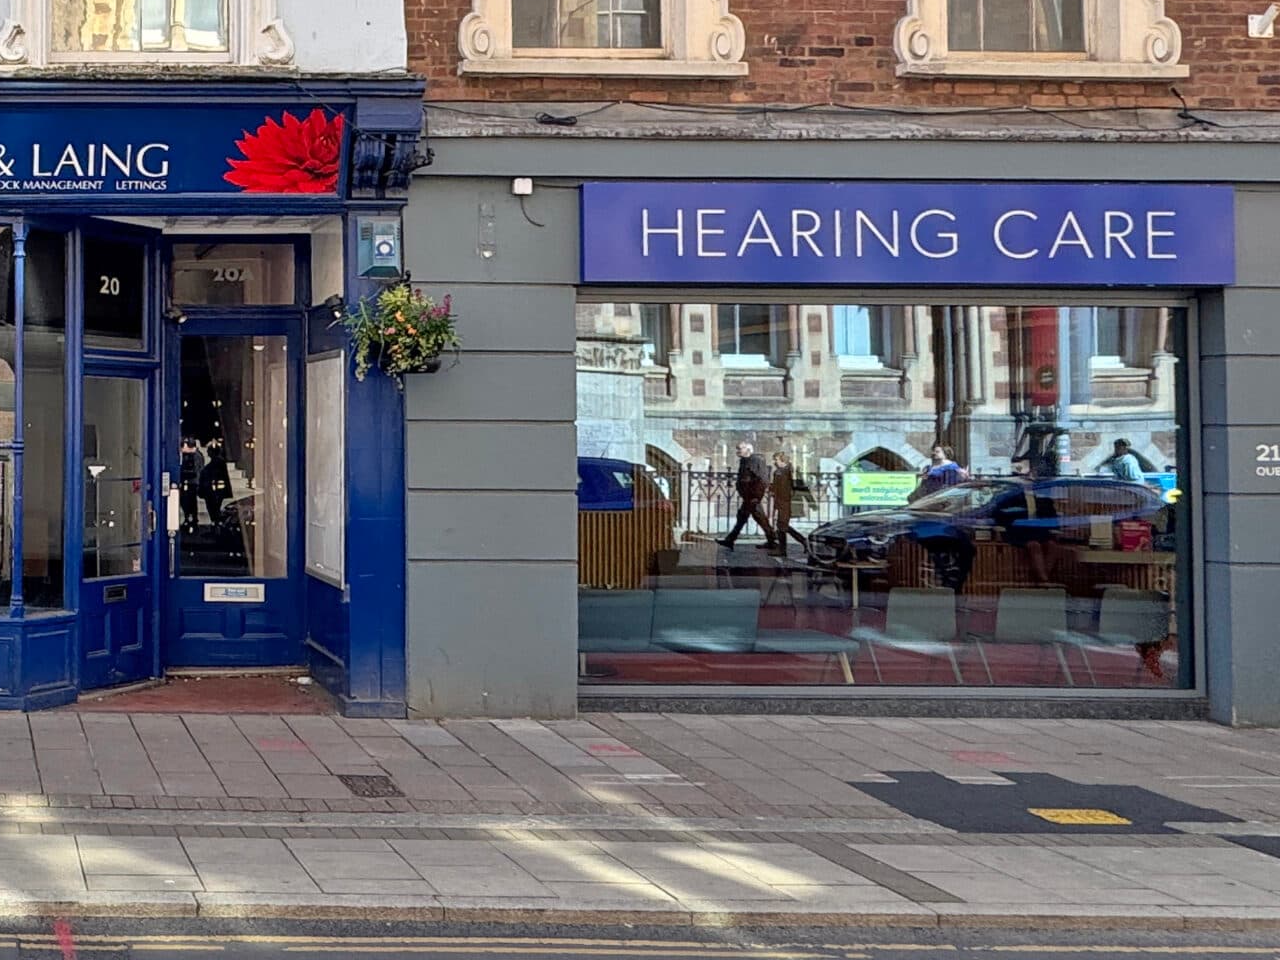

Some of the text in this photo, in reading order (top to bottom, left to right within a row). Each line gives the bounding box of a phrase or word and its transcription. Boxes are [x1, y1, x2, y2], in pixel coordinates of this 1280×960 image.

[32, 143, 170, 178] LAING
[22, 180, 104, 190] MANAGEMENT
[115, 180, 168, 190] LETTINGS
[641, 208, 1178, 260] HEARING CARE
[213, 267, 254, 282] 20A
[99, 275, 120, 296] 20
